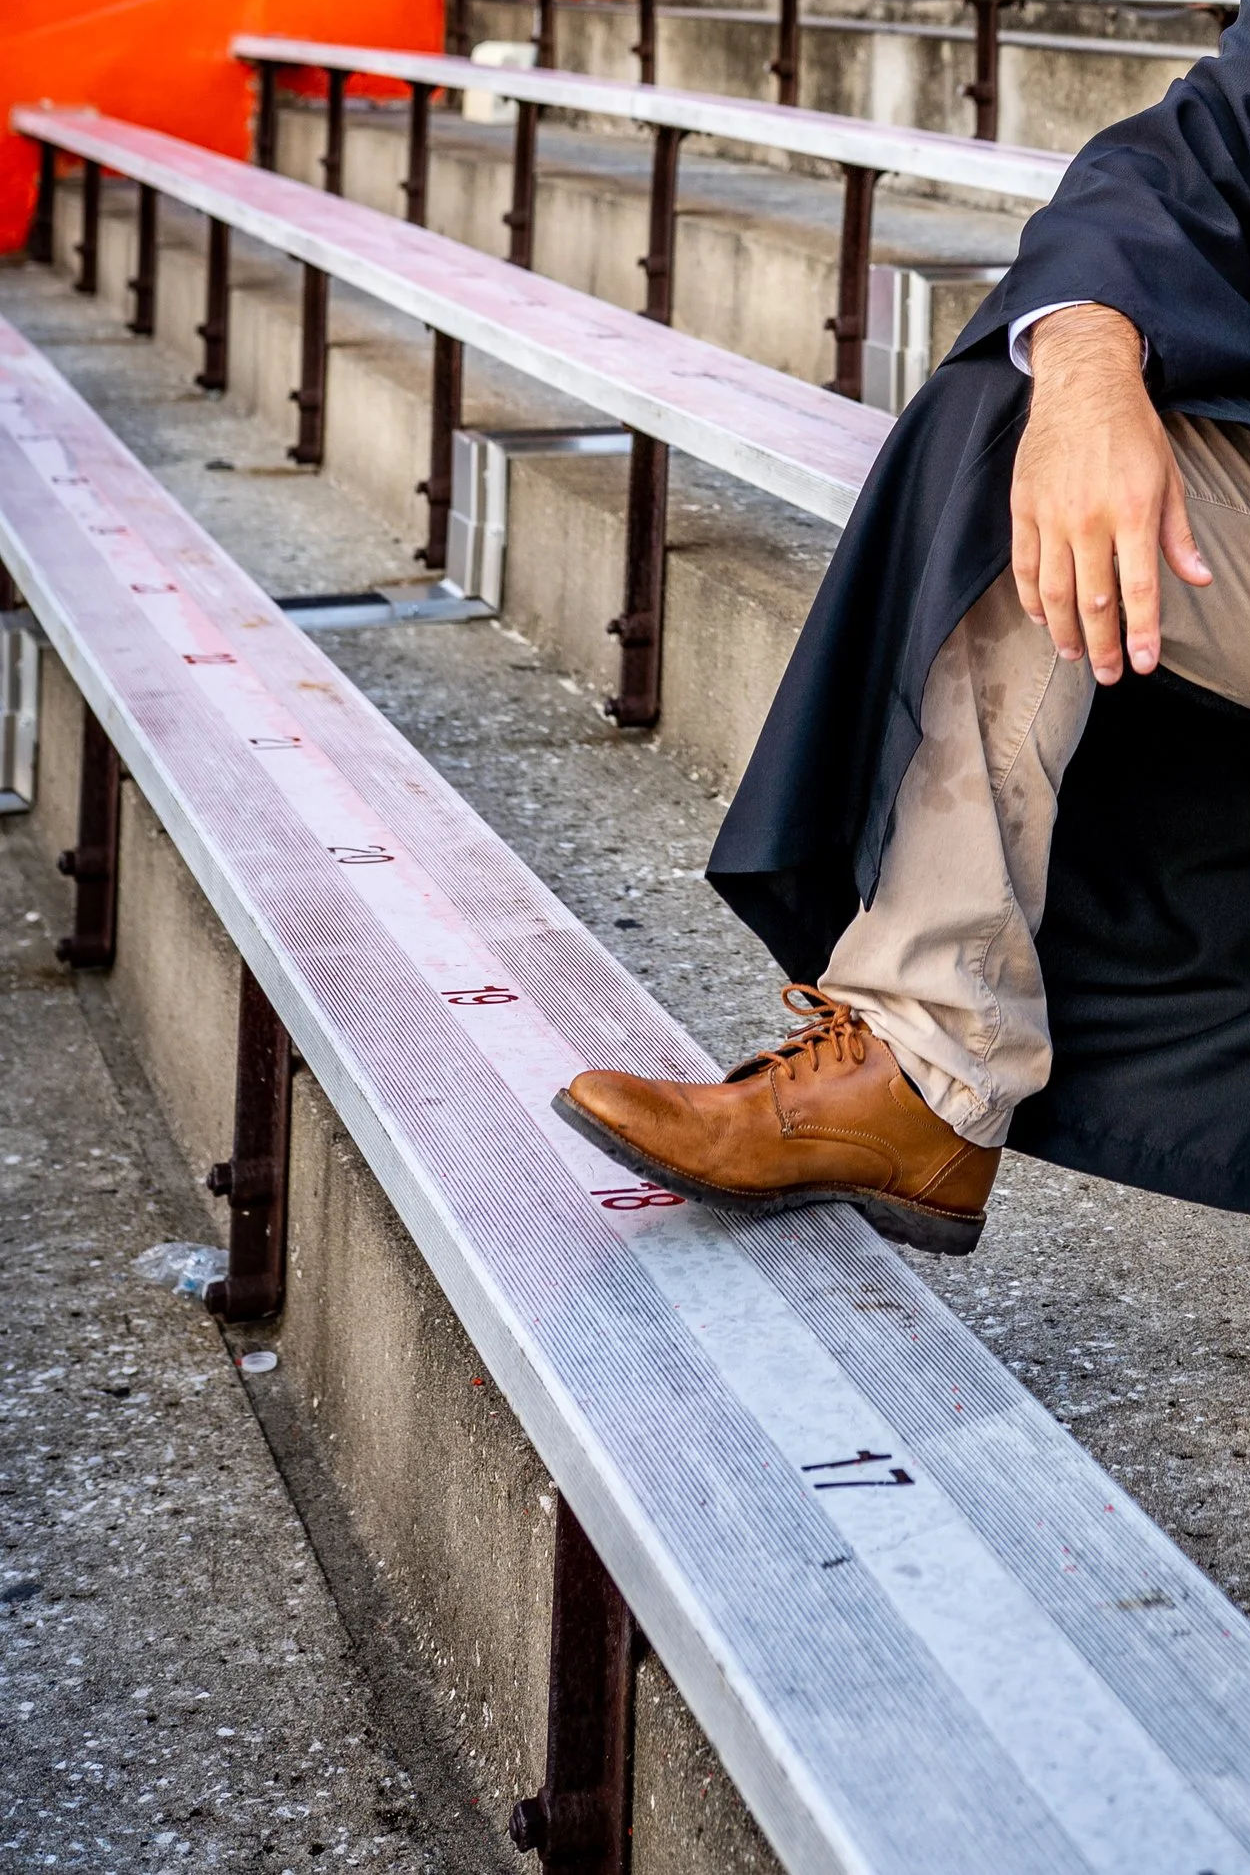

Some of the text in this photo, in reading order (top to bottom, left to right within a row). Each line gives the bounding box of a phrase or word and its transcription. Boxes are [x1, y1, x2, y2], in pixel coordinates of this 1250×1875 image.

[326, 844, 395, 865] 20
[440, 985, 519, 1006] 19
[589, 1181, 687, 1211] 18
[800, 1450, 916, 1490] 17
